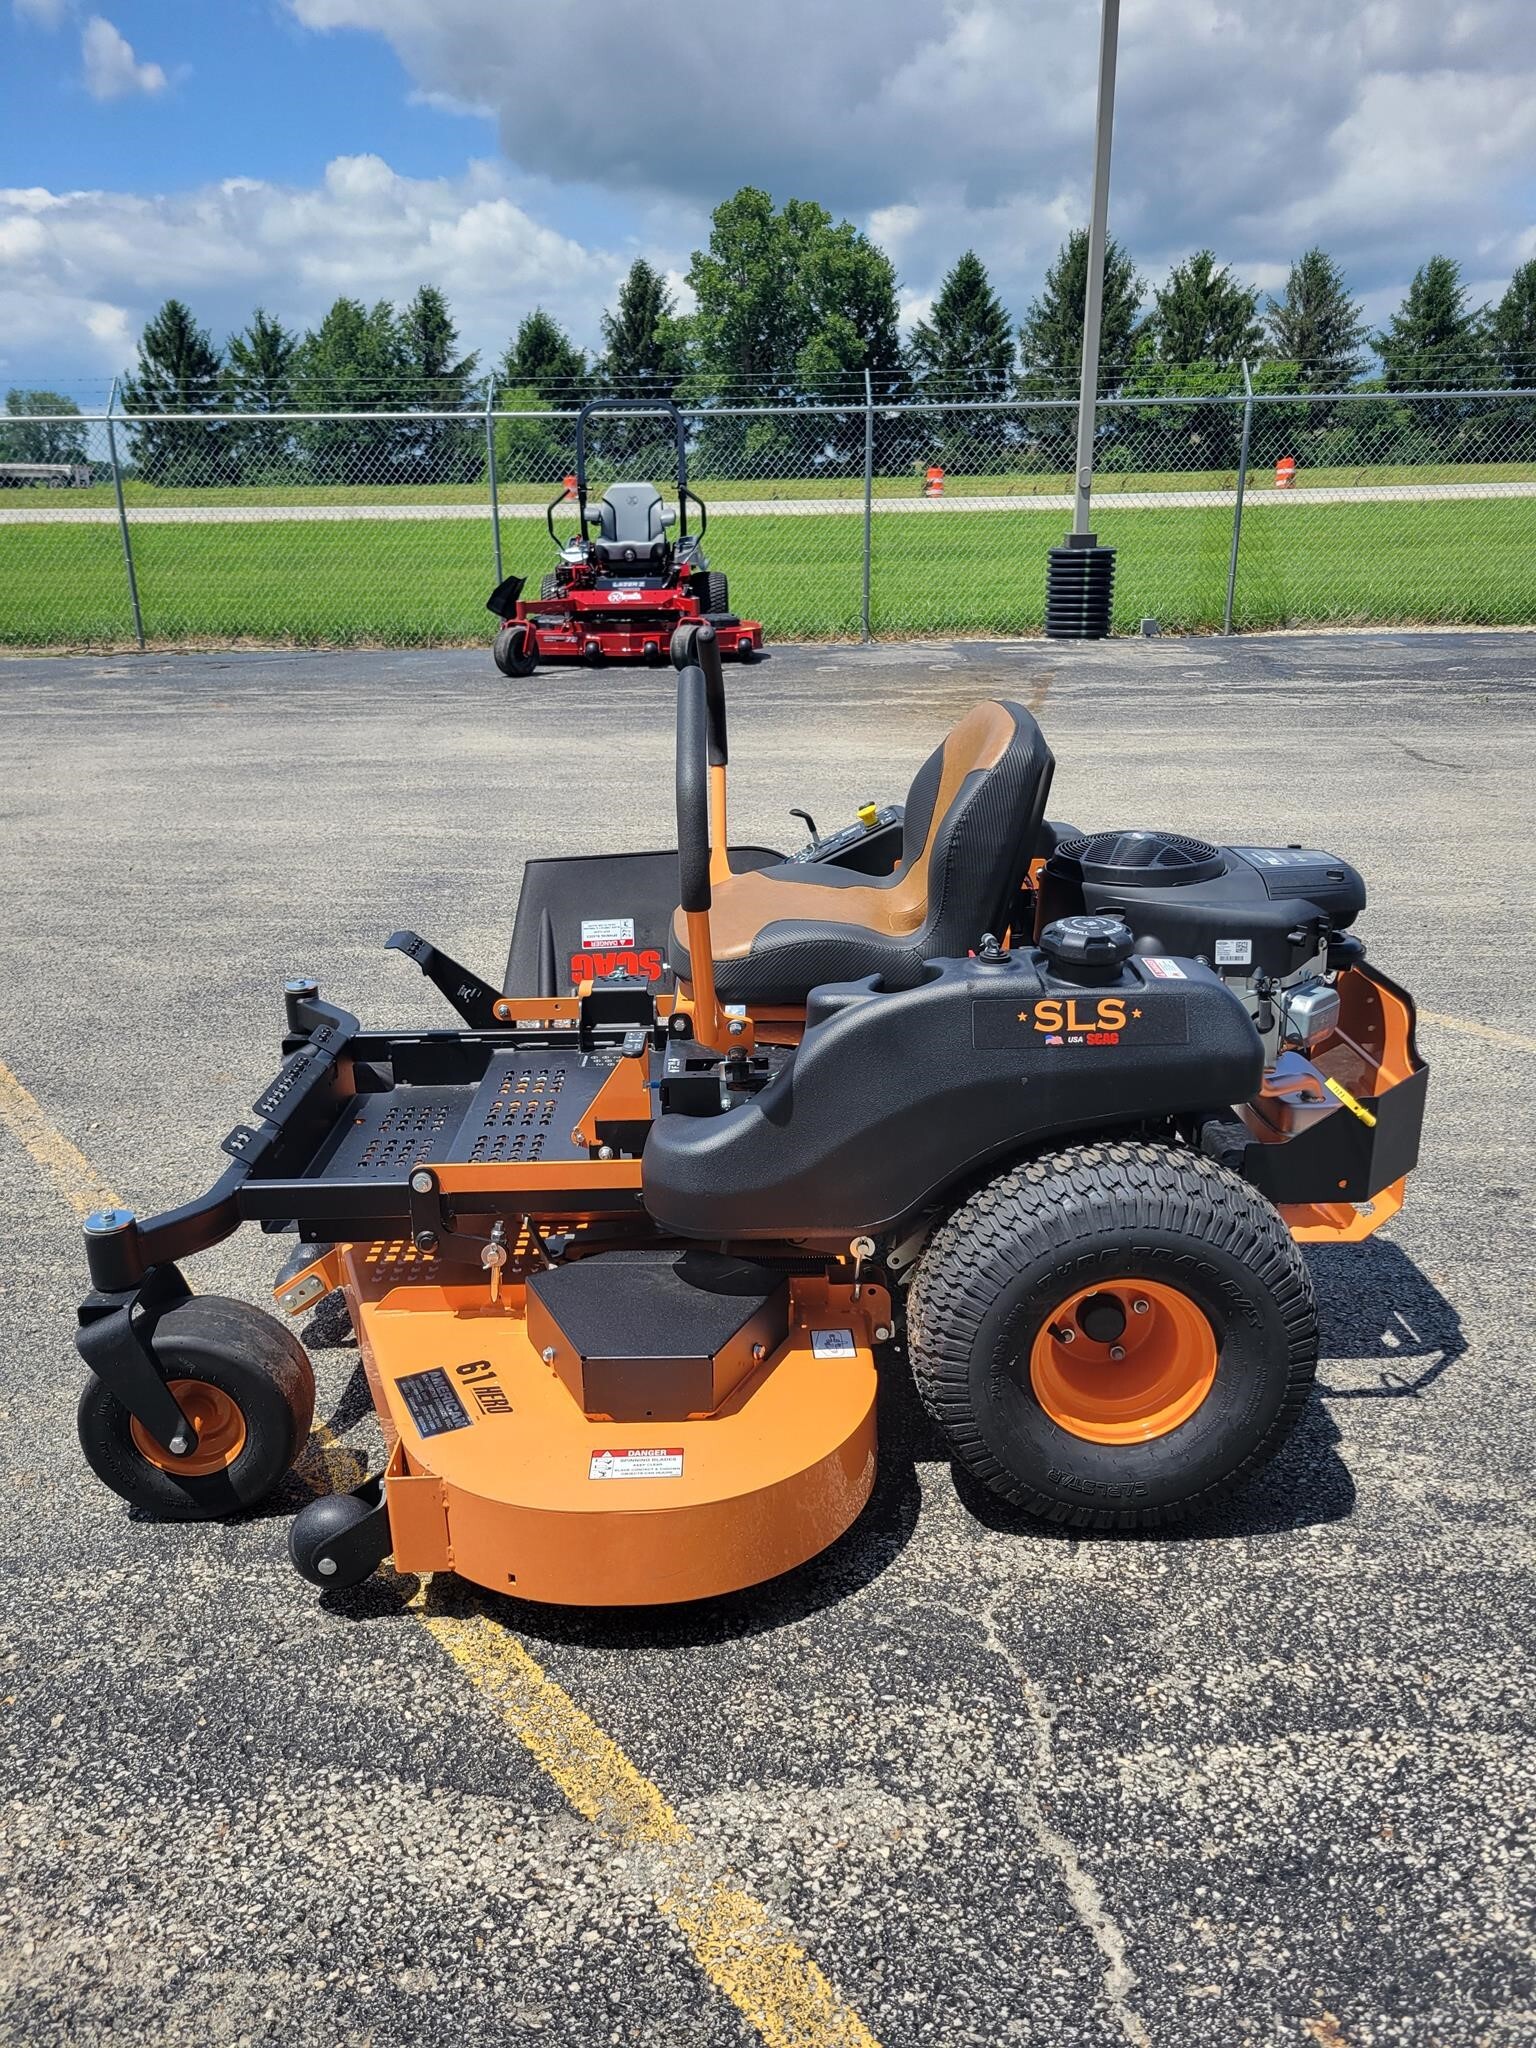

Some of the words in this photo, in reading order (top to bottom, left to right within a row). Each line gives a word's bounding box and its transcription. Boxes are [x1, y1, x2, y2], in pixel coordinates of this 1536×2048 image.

[570, 950, 662, 984] SCAG
[1034, 999, 1127, 1032] SLS
[1086, 1033, 1119, 1046] SCAG
[456, 1359, 498, 1385] 61
[428, 1371, 468, 1428] AMERICAN
[473, 1386, 514, 1414] HERO
